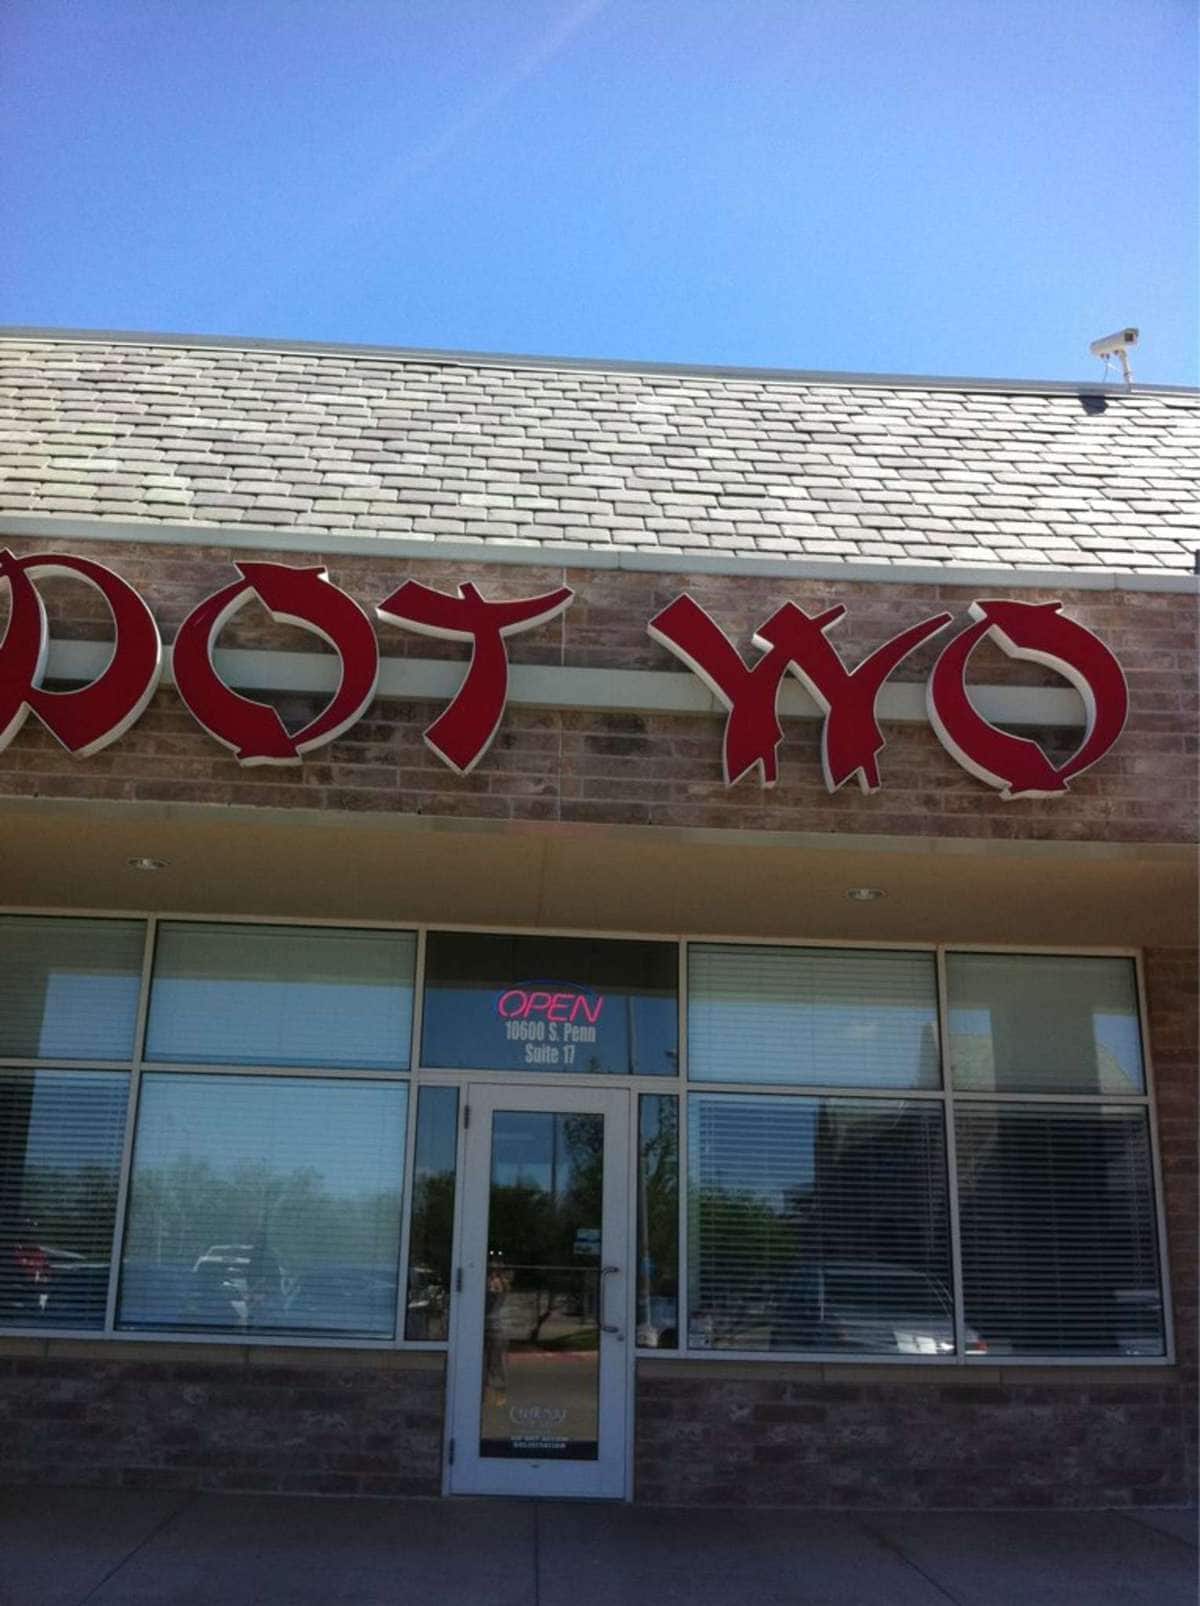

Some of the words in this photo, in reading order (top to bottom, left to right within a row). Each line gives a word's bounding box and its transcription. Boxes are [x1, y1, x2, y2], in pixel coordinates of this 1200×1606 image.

[647, 592, 1129, 800] WO
[498, 989, 604, 1023] OPEN
[505, 1020, 546, 1041] 10600
[548, 1021, 560, 1042] S.
[563, 1022, 597, 1043] Penn
[525, 1043, 560, 1064] Suite
[563, 1044, 576, 1065] 17
